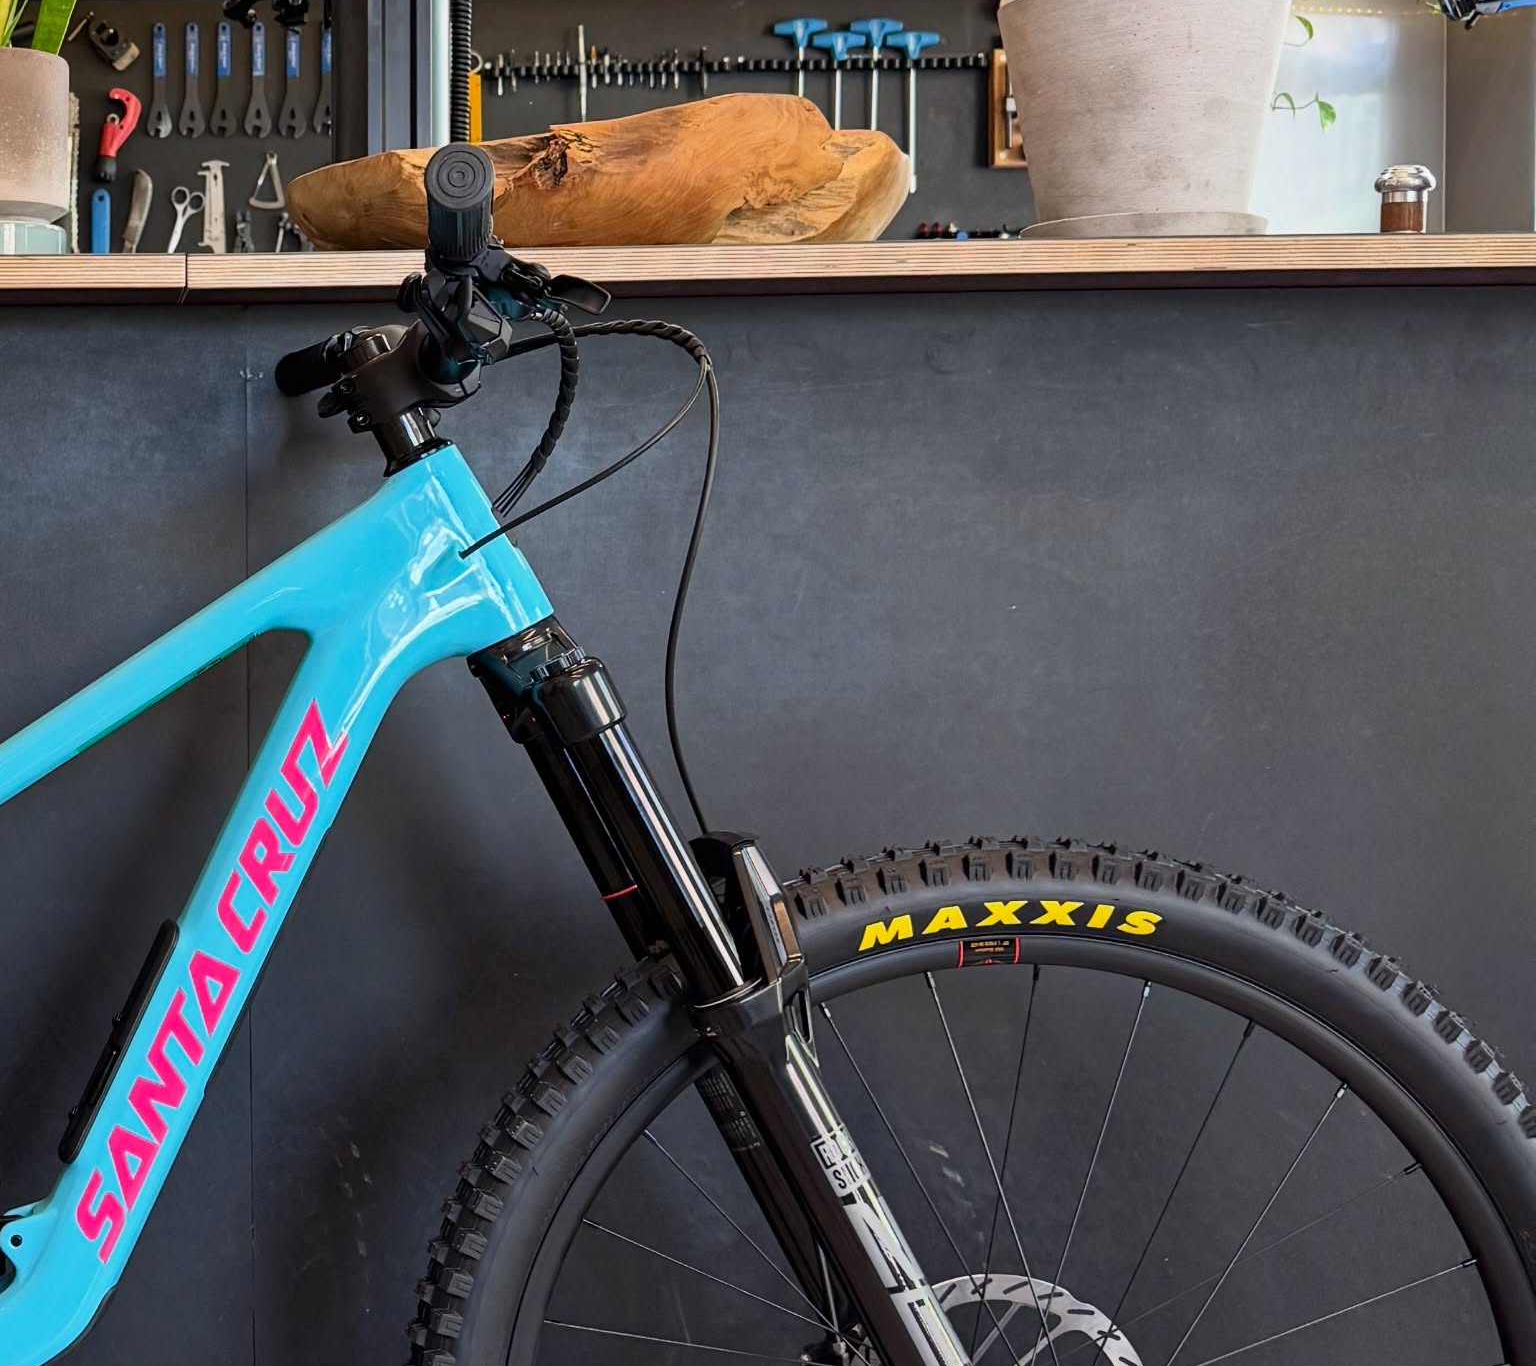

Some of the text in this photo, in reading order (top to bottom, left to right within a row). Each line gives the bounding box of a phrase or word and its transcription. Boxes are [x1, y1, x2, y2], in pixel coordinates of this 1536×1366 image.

[76, 698, 350, 1265] SANTA CRUZ
[859, 900, 1164, 952] MAXXIS
